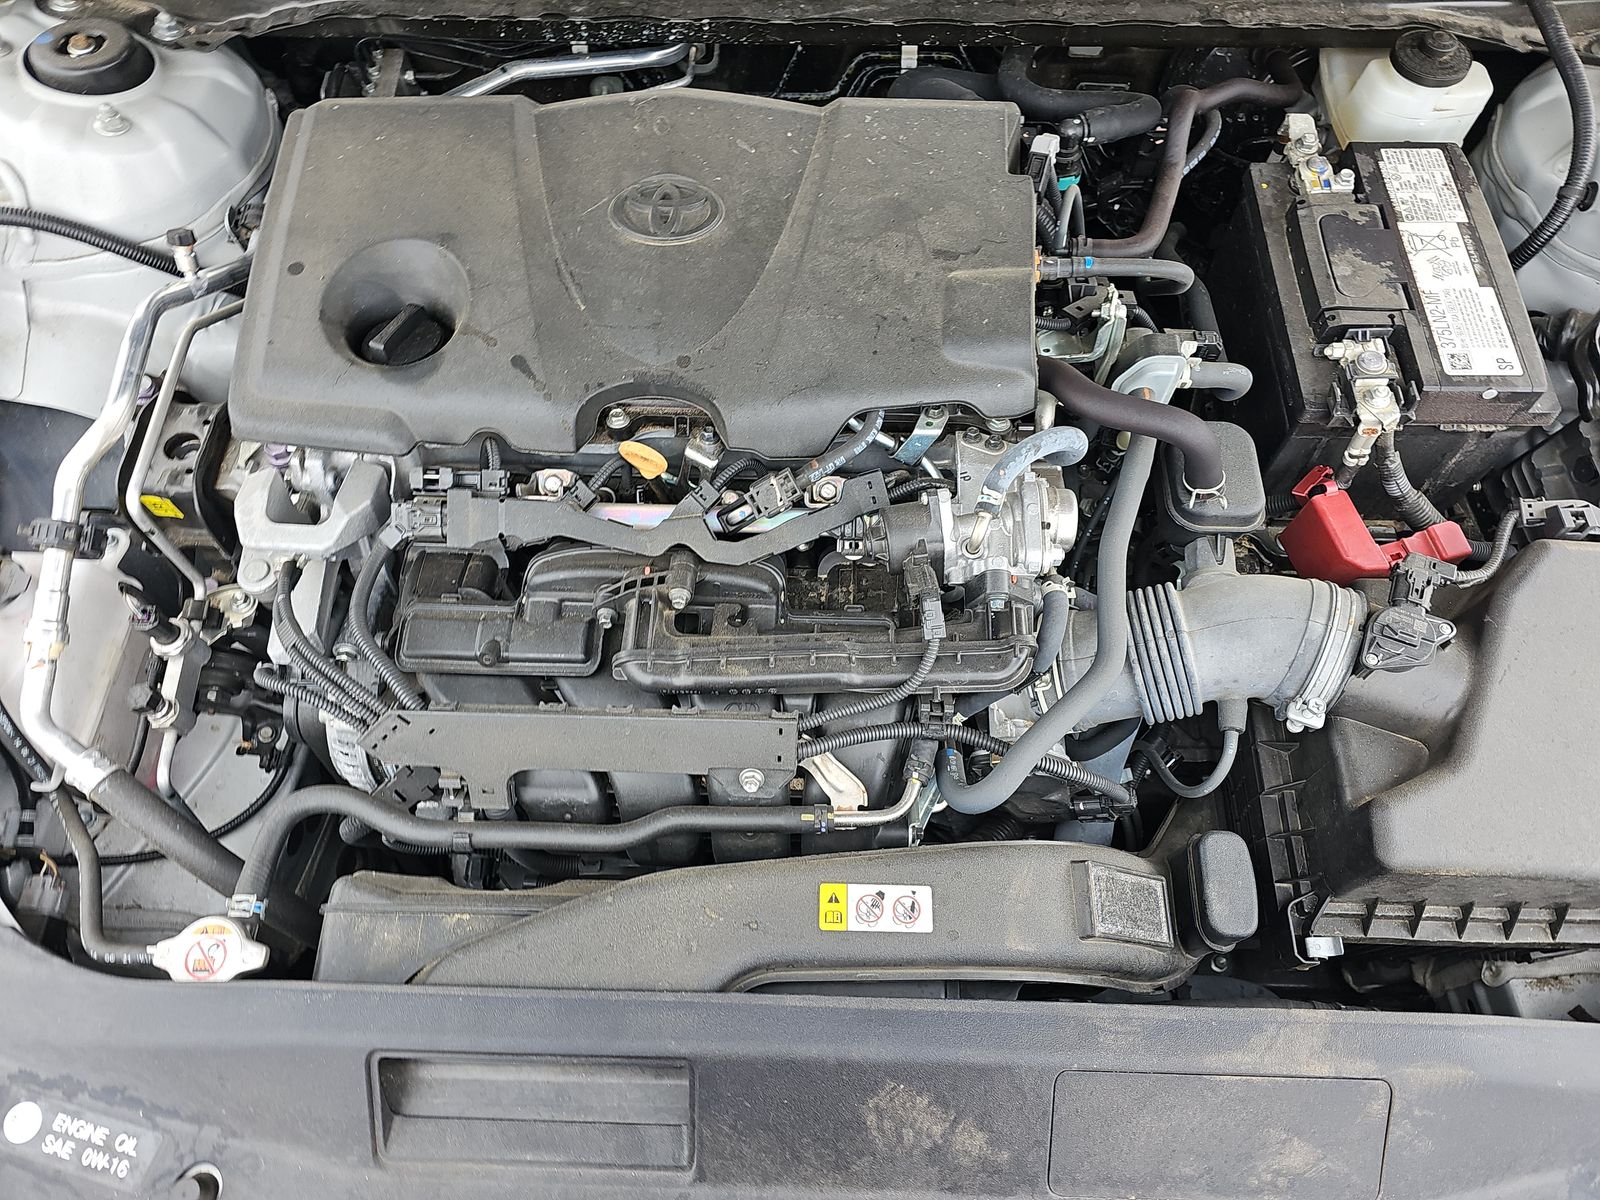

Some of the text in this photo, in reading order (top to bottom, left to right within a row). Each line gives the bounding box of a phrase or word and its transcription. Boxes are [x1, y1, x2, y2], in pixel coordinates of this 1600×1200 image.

[1449, 236, 1461, 248] Pb
[1422, 288, 1456, 349] 375LN2-MF
[1496, 358, 1514, 370] SP
[42, 1134, 130, 1179] SAE 0W-16
[52, 1112, 138, 1158] ENGINE OIL
